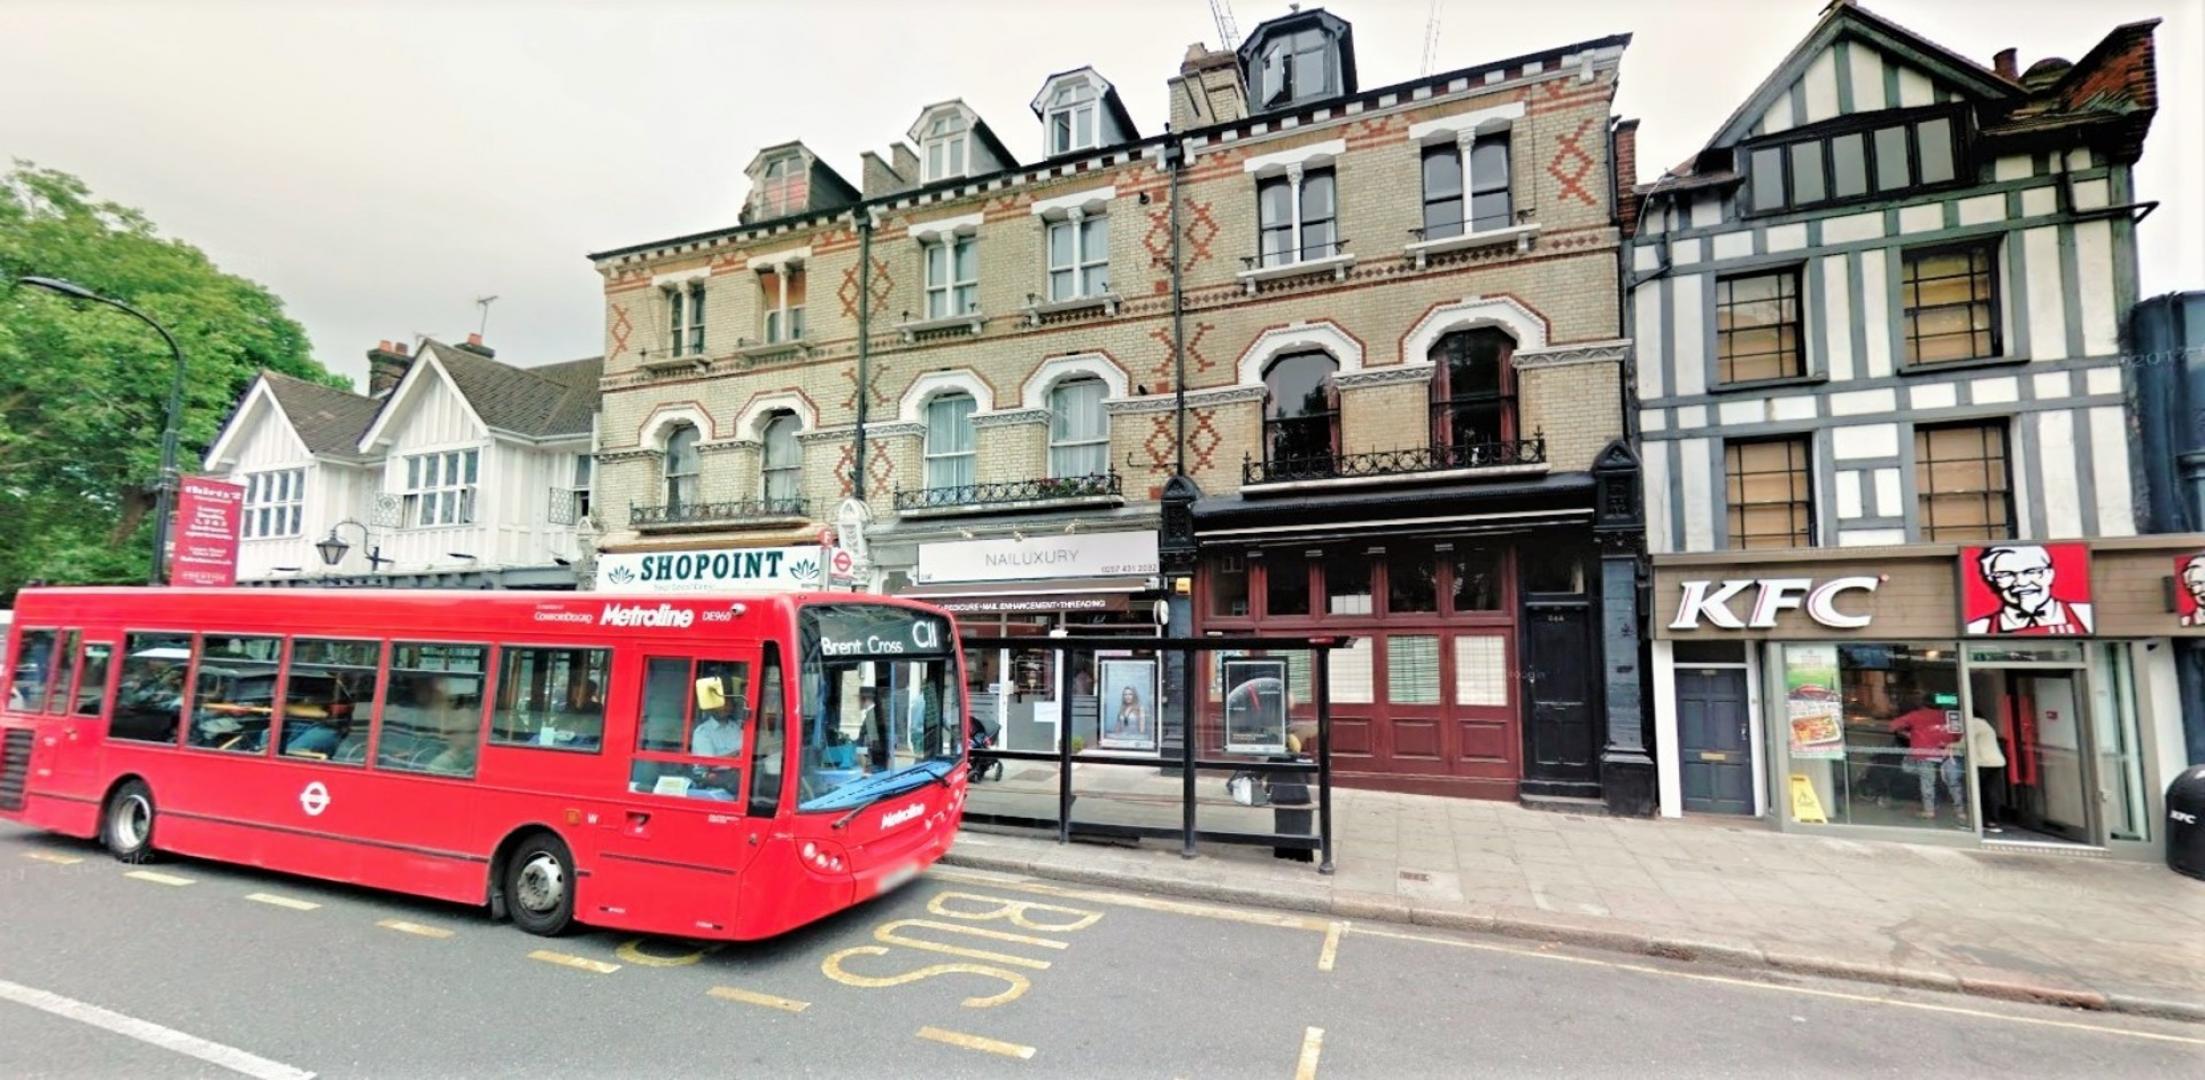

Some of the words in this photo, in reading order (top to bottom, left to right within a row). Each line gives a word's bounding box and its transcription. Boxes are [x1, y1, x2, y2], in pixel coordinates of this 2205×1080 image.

[640, 551, 784, 581] SHOPOINT
[985, 549, 1080, 567] NAILUXURY
[599, 603, 695, 629] Metroline
[1060, 599, 1106, 609] THREADING
[1668, 574, 1881, 630] KFC
[821, 636, 863, 656] Brent
[867, 635, 904, 653] Cross
[912, 620, 938, 648] C11
[821, 891, 1106, 1008] BUS
